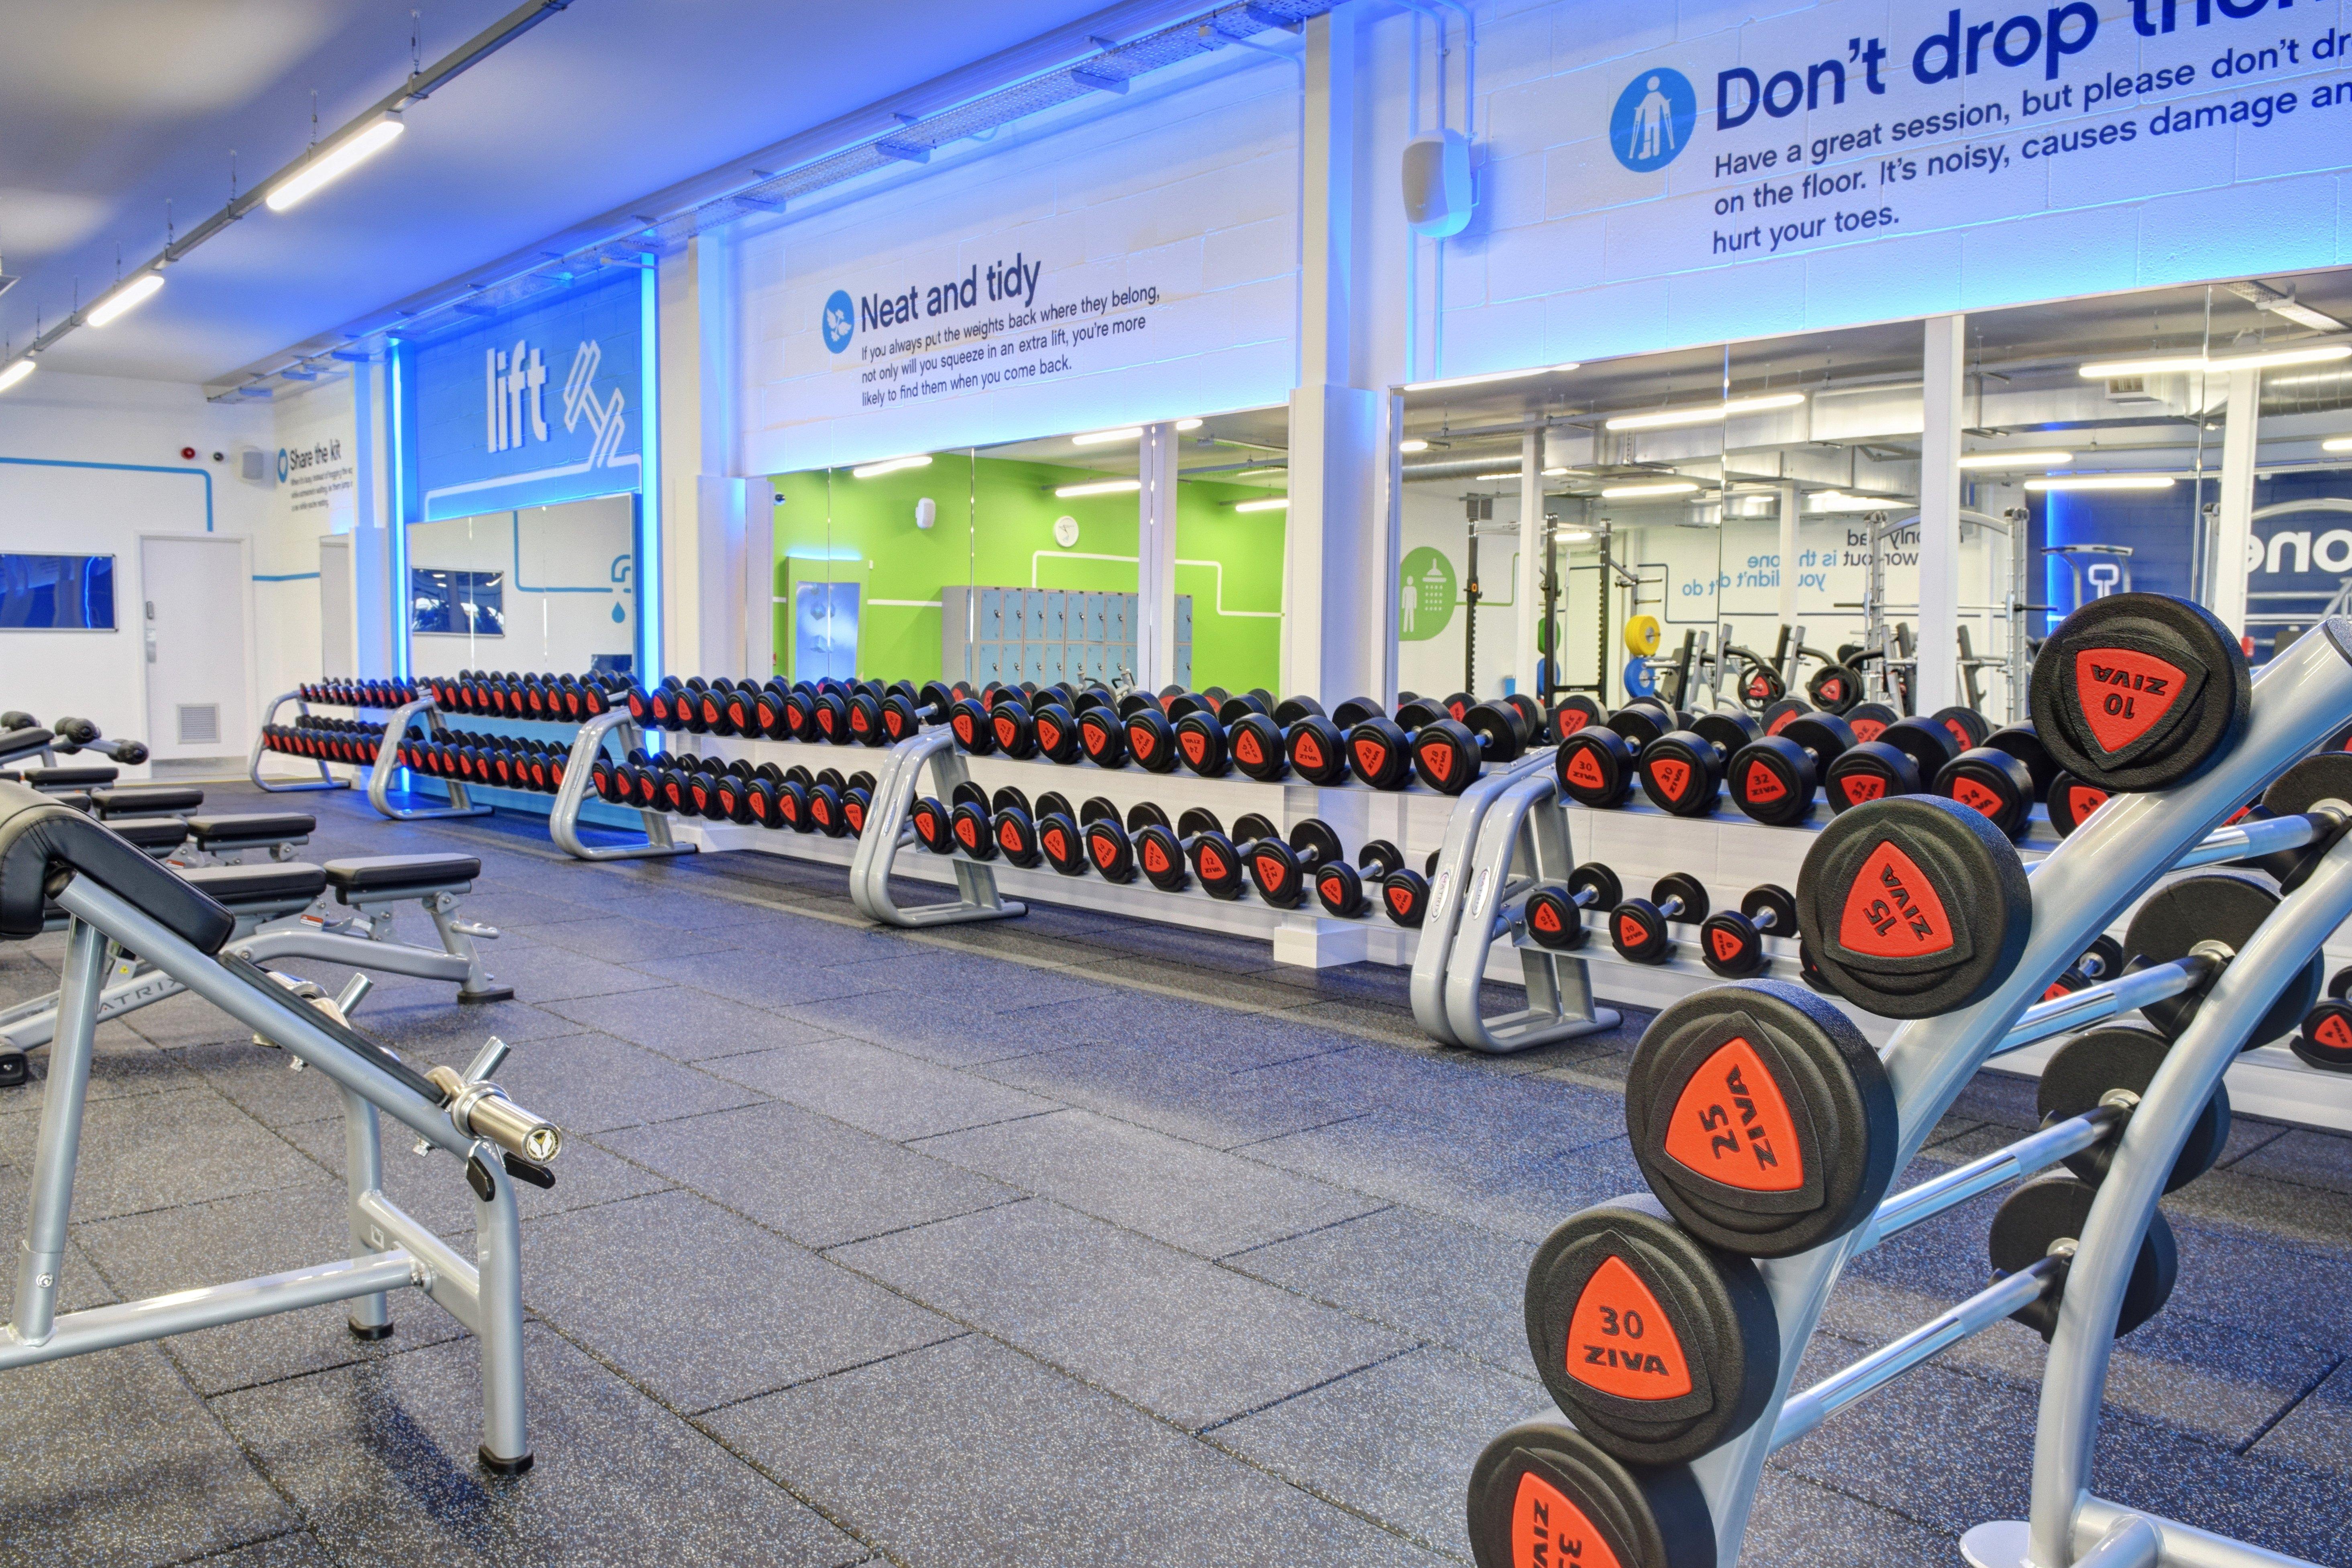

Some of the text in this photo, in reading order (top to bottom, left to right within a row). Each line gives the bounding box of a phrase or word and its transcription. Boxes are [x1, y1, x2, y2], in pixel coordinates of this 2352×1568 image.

[1717, 37, 1886, 130] Don't
[1913, 2, 2098, 84] drop
[1716, 150, 1777, 177] Have
[1787, 145, 1801, 162] a
[1812, 124, 1881, 165] great
[1892, 104, 2009, 141] session,
[2023, 85, 2072, 116] but
[2084, 65, 2195, 112] please
[2212, 39, 2299, 78] don't
[1715, 195, 1744, 215] on
[1754, 183, 1793, 207] the
[1803, 172, 1865, 199] floor.
[1880, 158, 1916, 185] It's
[1928, 145, 2009, 175] noisy,
[2022, 121, 2136, 159] causes
[2150, 93, 2297, 135] damage
[1714, 207, 1899, 254] hurt your toes.
[862, 253, 1041, 332] Neat and tidy
[862, 287, 1160, 362] If you always put the weights back where they belong,
[862, 317, 1145, 383] not only will you squeeze in an extra lift, you're more
[862, 354, 1072, 407] likely to find them when you come back.
[487, 340, 548, 453] lift
[2091, 664, 2168, 696] ZIVA
[2104, 693, 2135, 719] 10
[1089, 731, 1095, 740] 22
[1092, 735, 1101, 749] ZIVA
[1137, 735, 1143, 744] 24
[1140, 739, 1150, 753] ZIVA
[1246, 737, 1257, 757] ZIVA
[1368, 751, 1380, 769] ZIVA
[1438, 751, 1446, 774] ZIVA
[1580, 762, 1592, 771] 30
[1573, 772, 1597, 781] ZIVA
[1661, 768, 1672, 781] 30
[1669, 769, 1683, 793] ZIVA
[1753, 774, 1769, 785] 32
[1751, 785, 1778, 796] ZIVA
[1852, 782, 1866, 798] 32
[1864, 784, 1878, 801] IVA
[1961, 790, 1979, 804] 34
[2079, 797, 2098, 813] 34
[1102, 848, 1112, 862] ZIVA
[1261, 862, 1273, 886] ZIVA
[1270, 866, 1277, 877] 12
[1325, 887, 1338, 900] ZIVA
[1399, 895, 1408, 909] ZIVA
[1880, 863, 1933, 941] ZIVA
[1864, 899, 1897, 937] 15
[1625, 931, 1643, 941] ZIVA
[1718, 934, 1726, 956] ZIVA
[2332, 1020, 2348, 1044] ZIVA
[1726, 1065, 1777, 1170] ZIVA
[1699, 1104, 1740, 1159] 25
[1600, 1306, 1643, 1339] 30
[1584, 1345, 1669, 1376] ZIVA
[1533, 1499, 1549, 1568] ZIV
